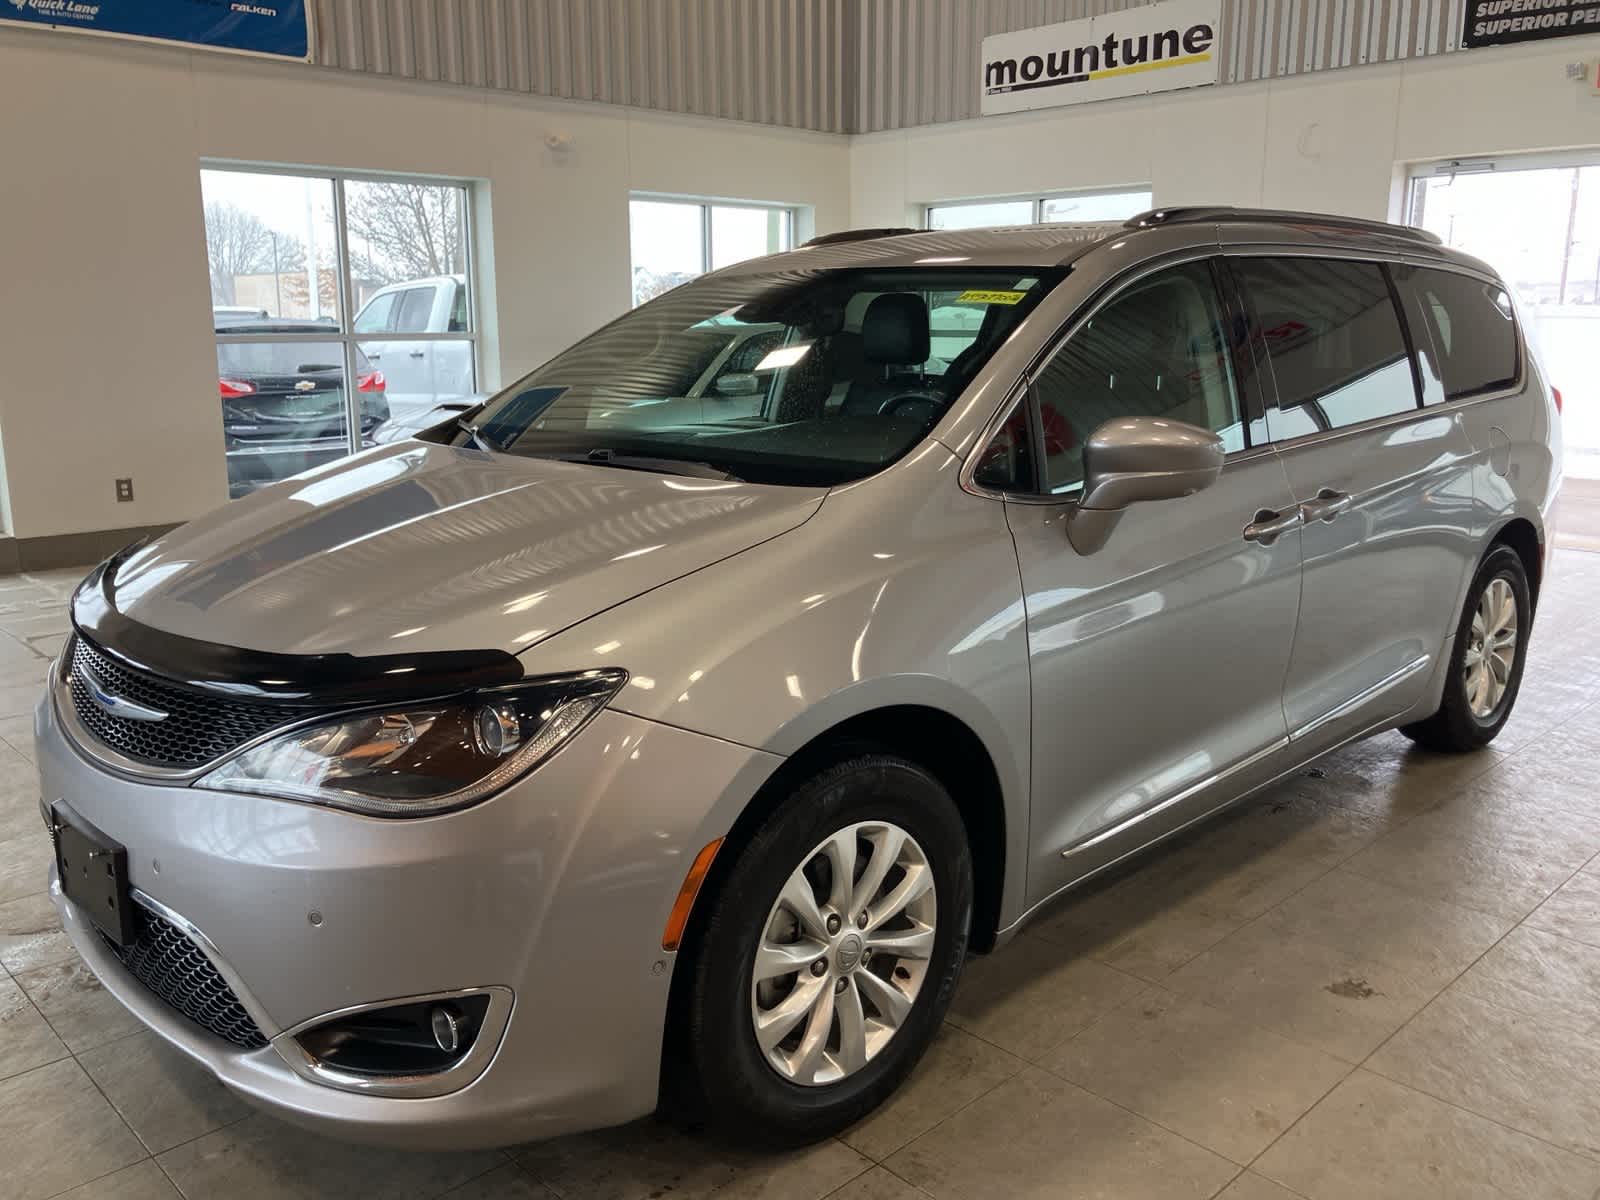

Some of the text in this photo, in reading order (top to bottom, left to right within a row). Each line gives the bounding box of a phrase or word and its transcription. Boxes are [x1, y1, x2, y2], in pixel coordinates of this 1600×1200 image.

[28, 0, 99, 15] Quick Lane
[1476, 0, 1570, 17] SUPERIOR
[1473, 12, 1568, 37] SUPERIOR
[985, 23, 1213, 87] mountune
